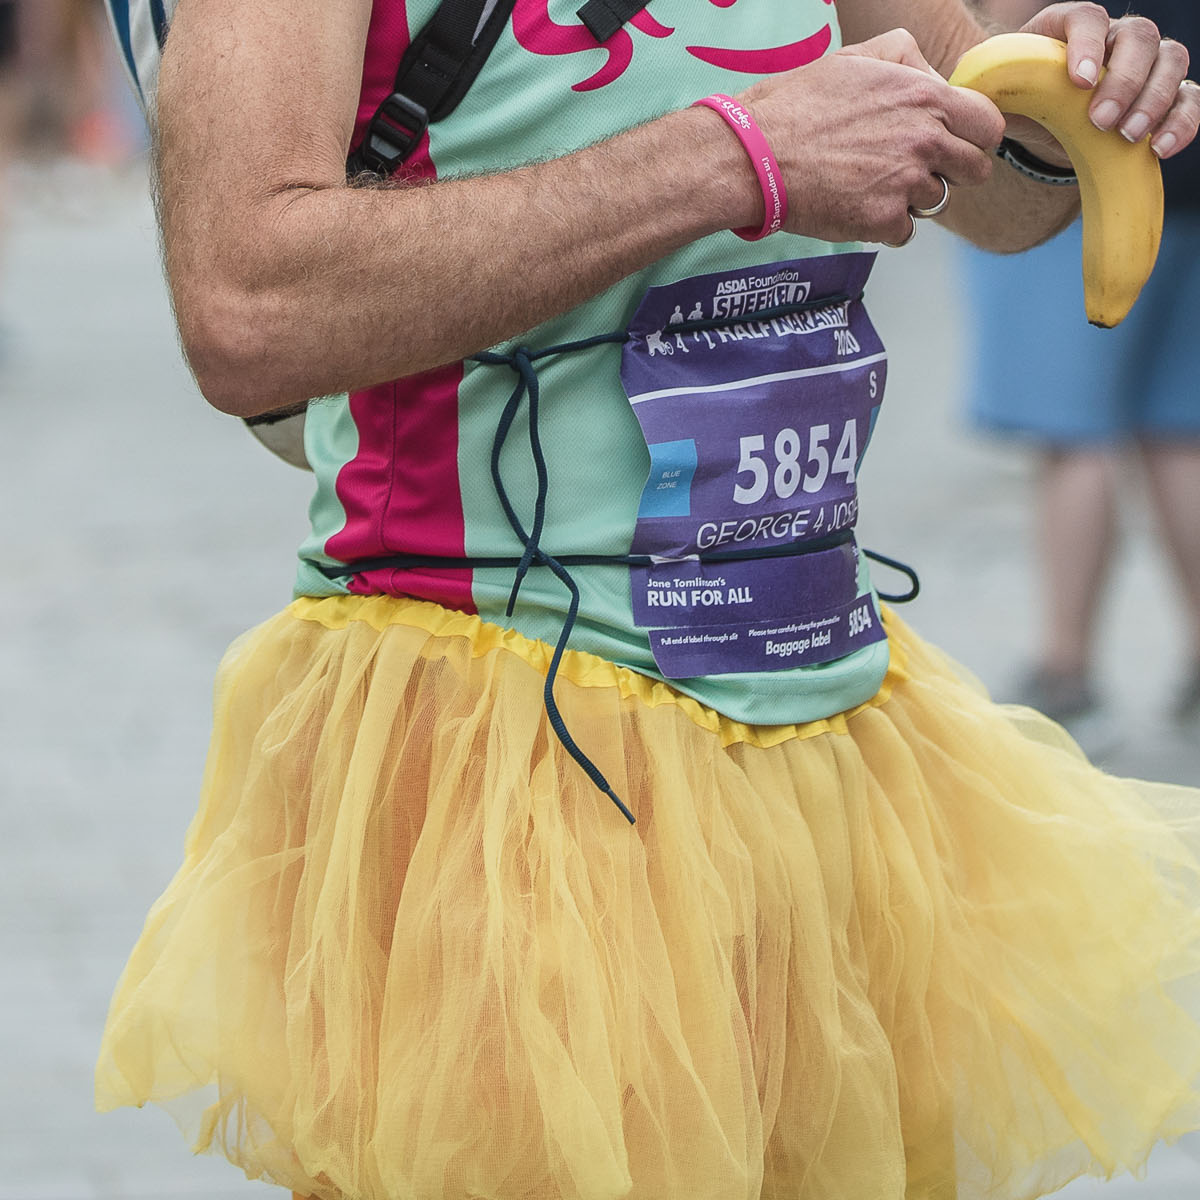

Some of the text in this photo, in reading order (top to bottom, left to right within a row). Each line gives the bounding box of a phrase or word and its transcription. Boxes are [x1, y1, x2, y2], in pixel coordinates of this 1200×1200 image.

[761, 156, 771, 172] I'm
[716, 271, 799, 296] ASDA Foundation
[715, 324, 770, 343] HALF
[733, 418, 858, 505] 5854
[662, 470, 681, 479] BLUE
[657, 481, 678, 490] ZONE
[696, 509, 811, 549] GEORGE
[647, 577, 726, 588] Jane Tomlinson's
[647, 587, 753, 607] RUN FOR ALL
[849, 604, 872, 637] 5854
[689, 635, 703, 643] label
[703, 633, 728, 643] through
[748, 629, 767, 637] Please
[766, 629, 831, 657] Baggage label
